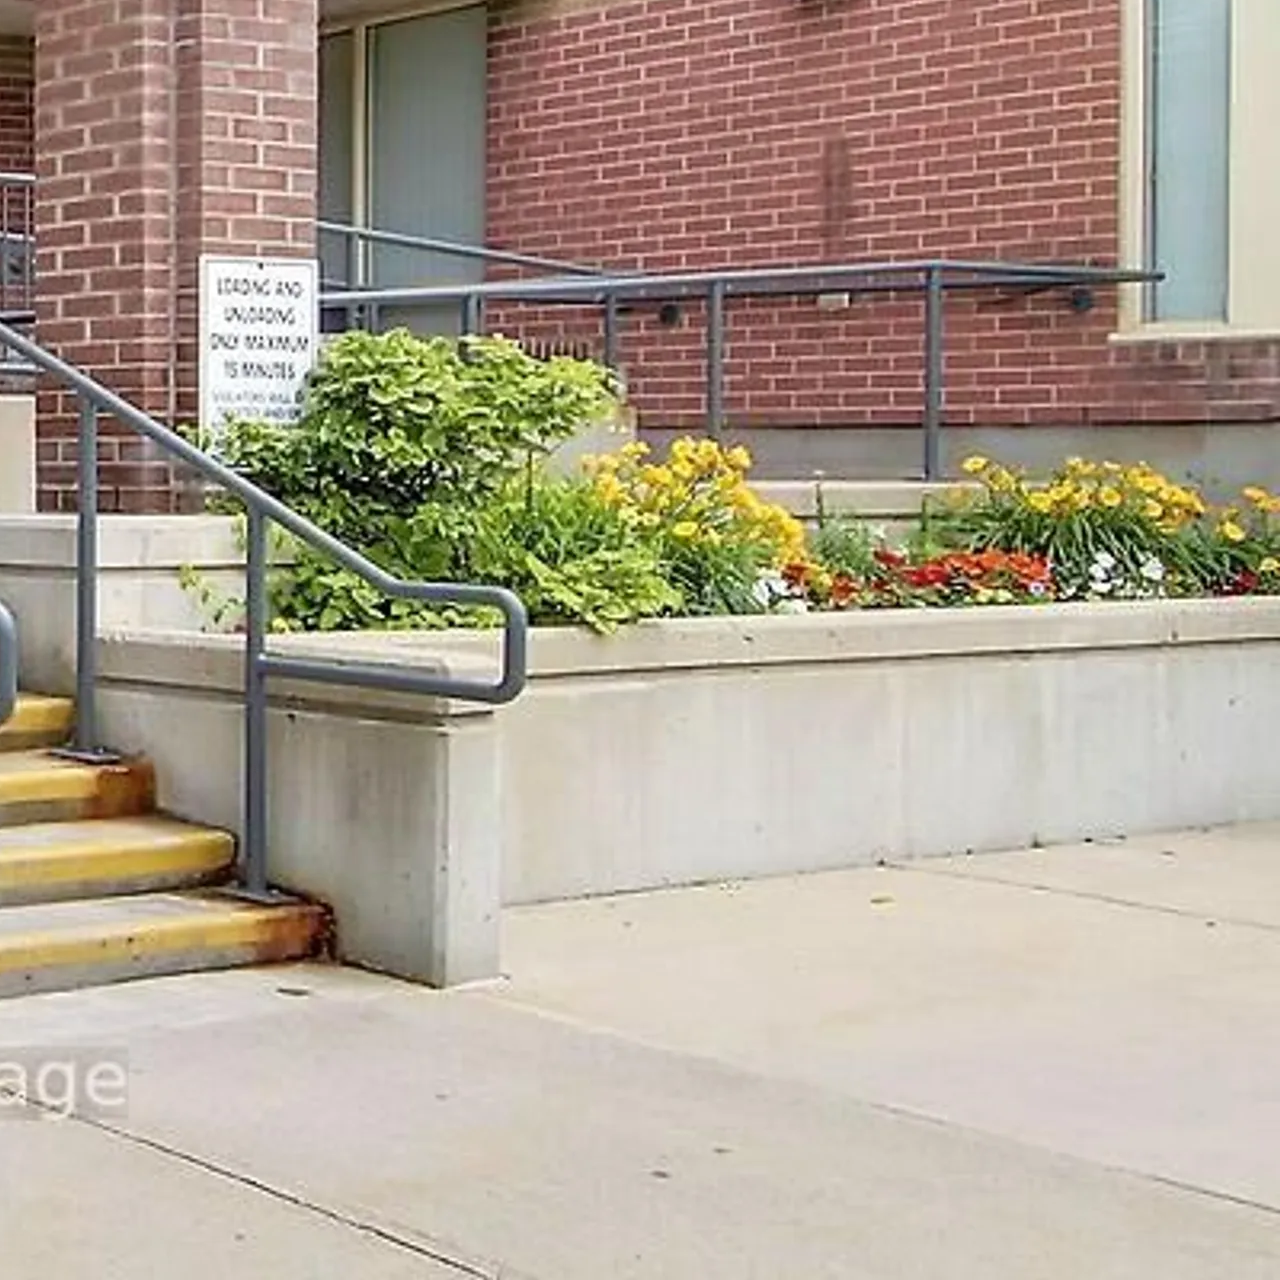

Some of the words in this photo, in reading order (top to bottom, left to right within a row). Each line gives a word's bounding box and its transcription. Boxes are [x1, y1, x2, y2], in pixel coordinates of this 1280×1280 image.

[217, 277, 271, 296] LOADING
[275, 280, 303, 299] AND
[223, 306, 296, 325] UNLOADING
[210, 332, 239, 351] ONLY
[243, 334, 309, 354] MAXIMUM
[243, 361, 296, 381] MINUTES
